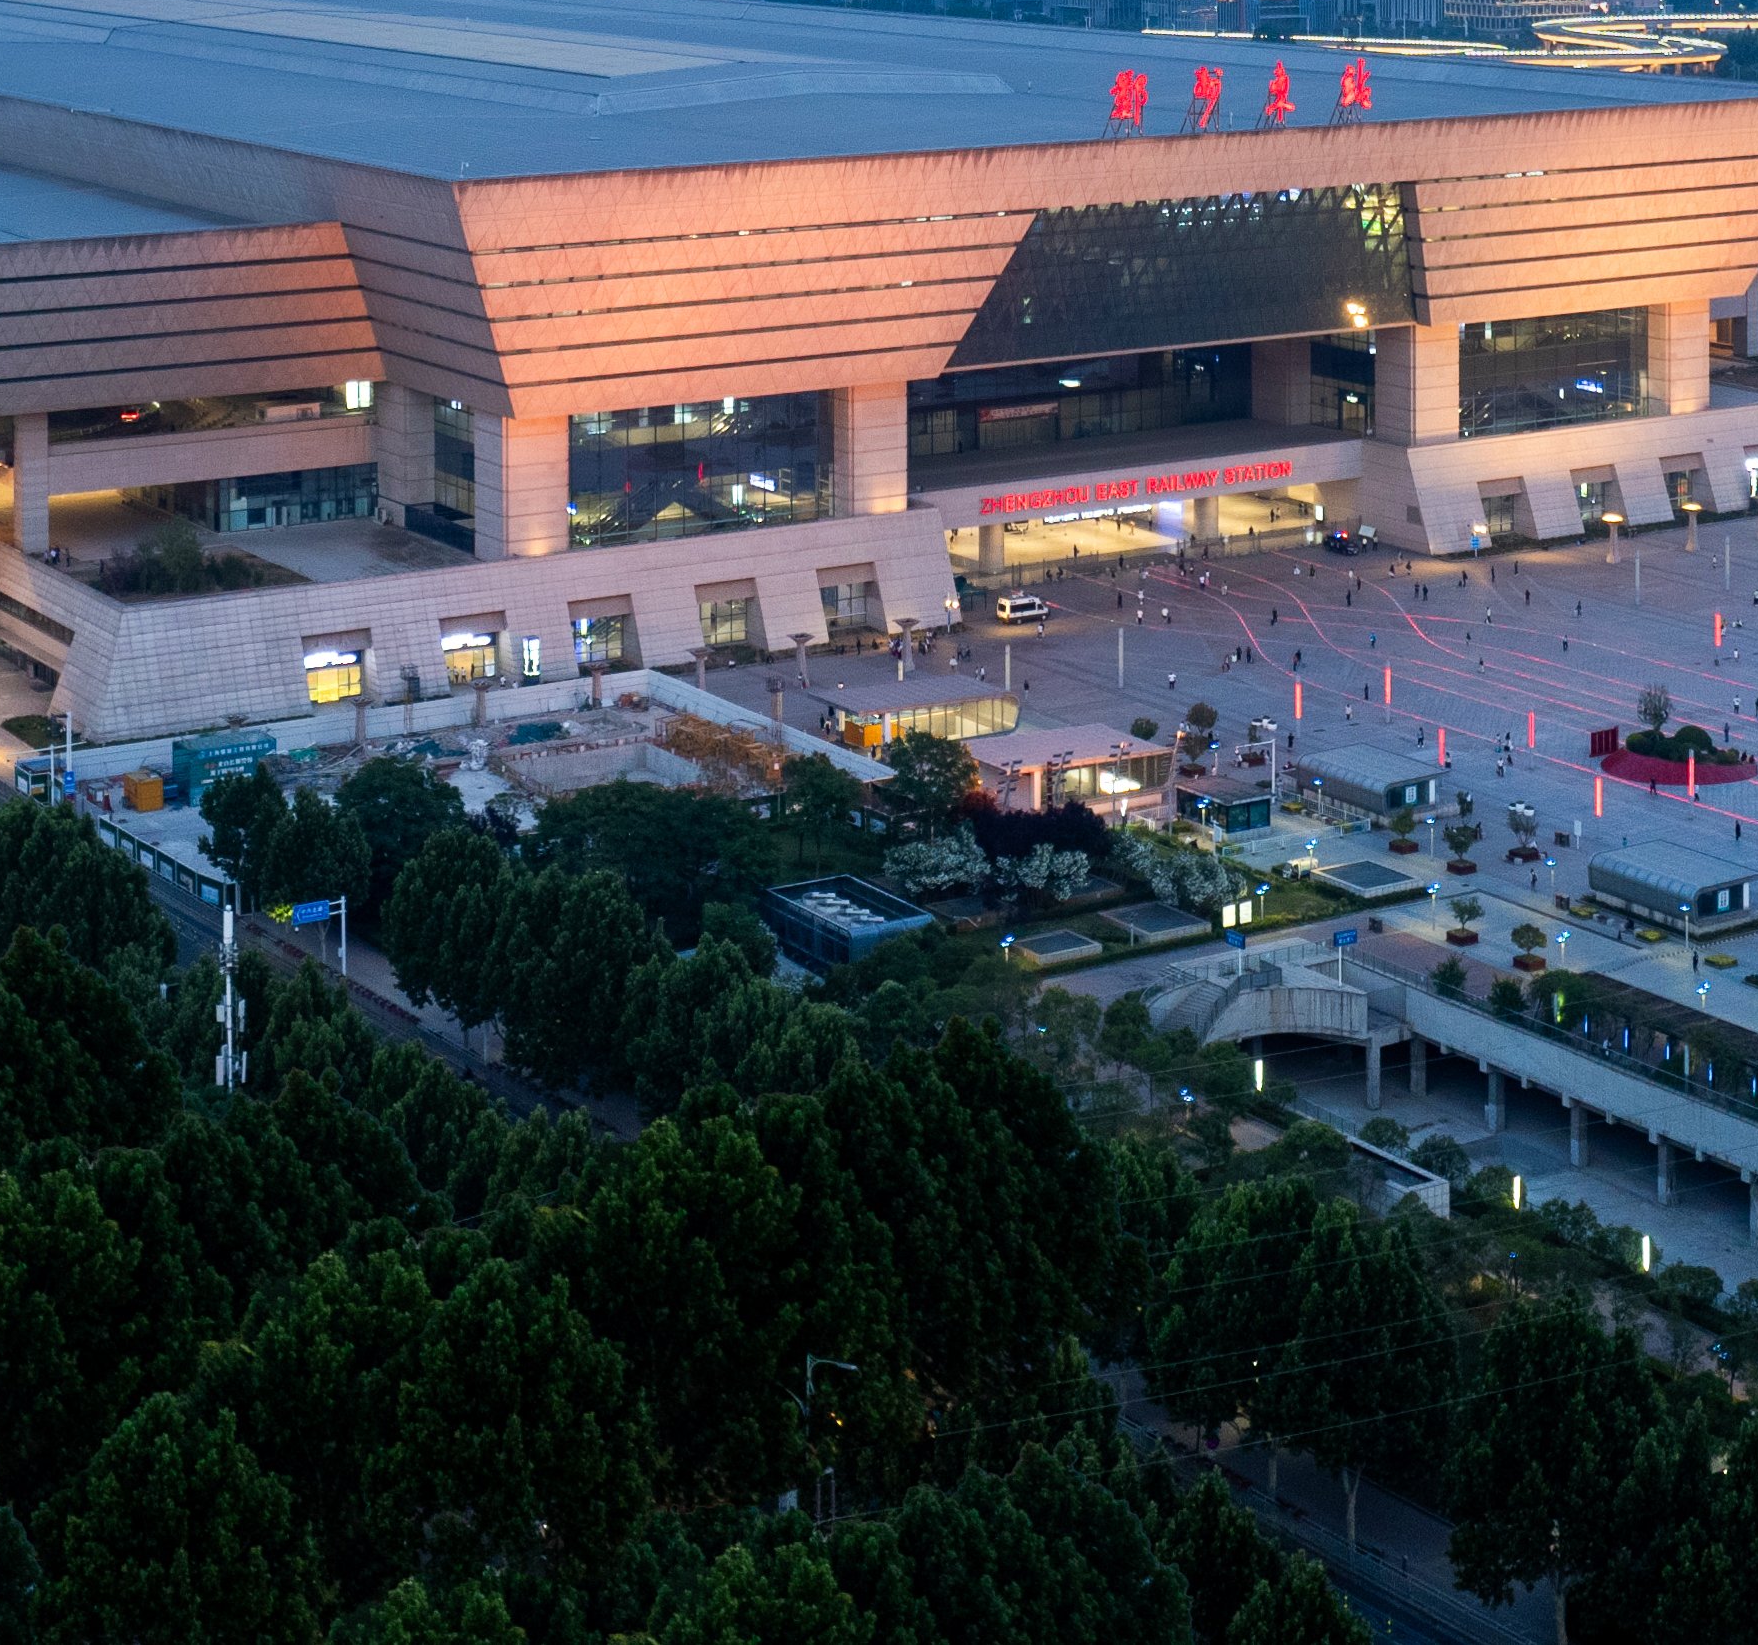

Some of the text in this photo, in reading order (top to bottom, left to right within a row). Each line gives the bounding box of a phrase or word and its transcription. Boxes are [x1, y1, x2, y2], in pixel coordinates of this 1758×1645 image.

[979, 483, 1090, 515] ZHENGZHOU
[1094, 478, 1139, 501] EAST
[1146, 468, 1219, 494] RAILWAY
[1223, 459, 1293, 485] STATION
